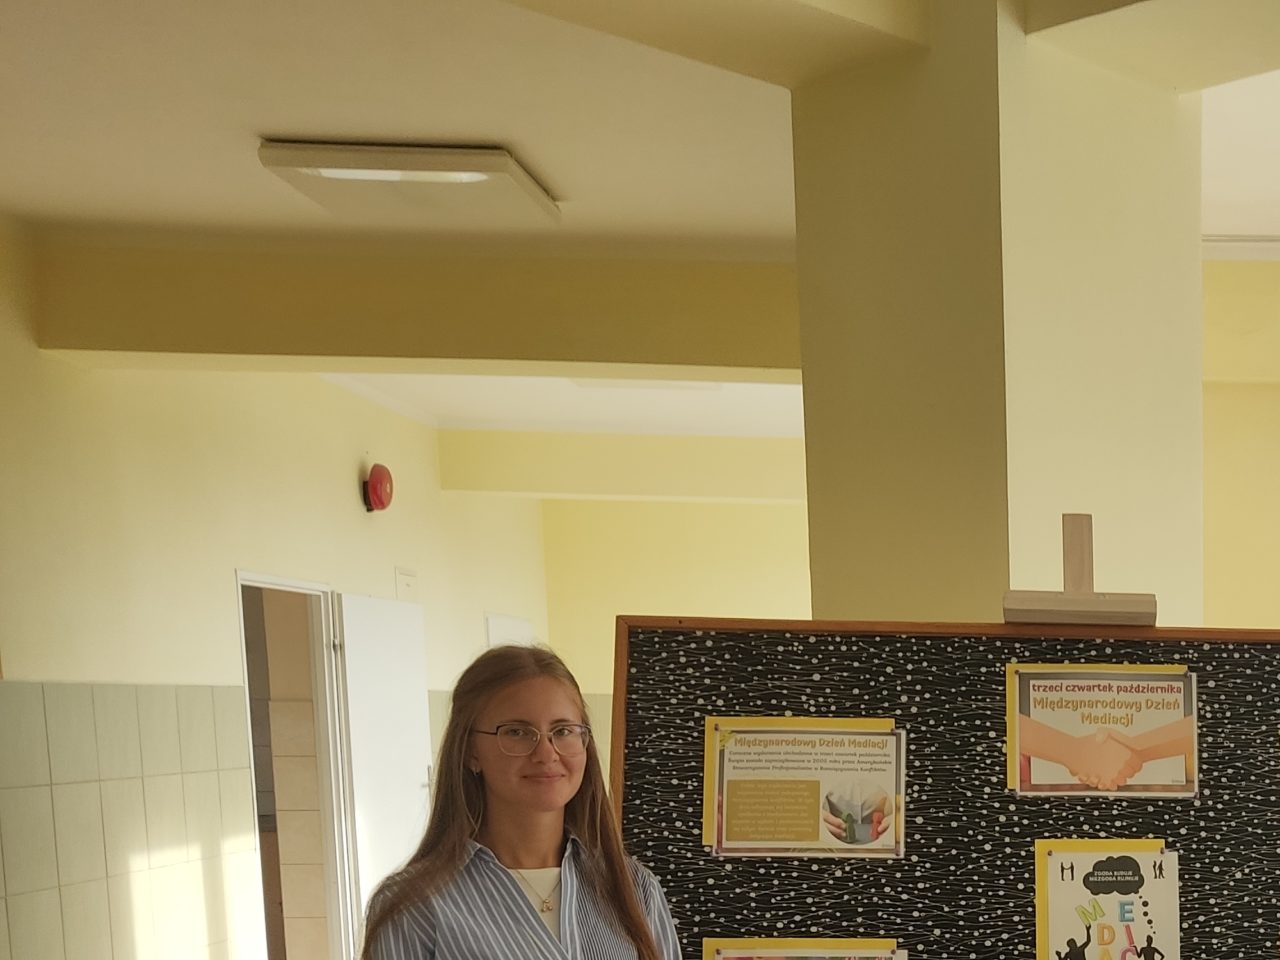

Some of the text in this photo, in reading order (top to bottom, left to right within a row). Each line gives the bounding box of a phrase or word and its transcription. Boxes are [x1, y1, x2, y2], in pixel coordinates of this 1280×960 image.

[1031, 682, 1182, 695] trzeci czwartek października
[1033, 697, 1181, 712] Międzynarodowy Dzień
[1081, 713, 1134, 727] Mediacji
[734, 737, 888, 750] Międzynarodowy Dzień Mediacji
